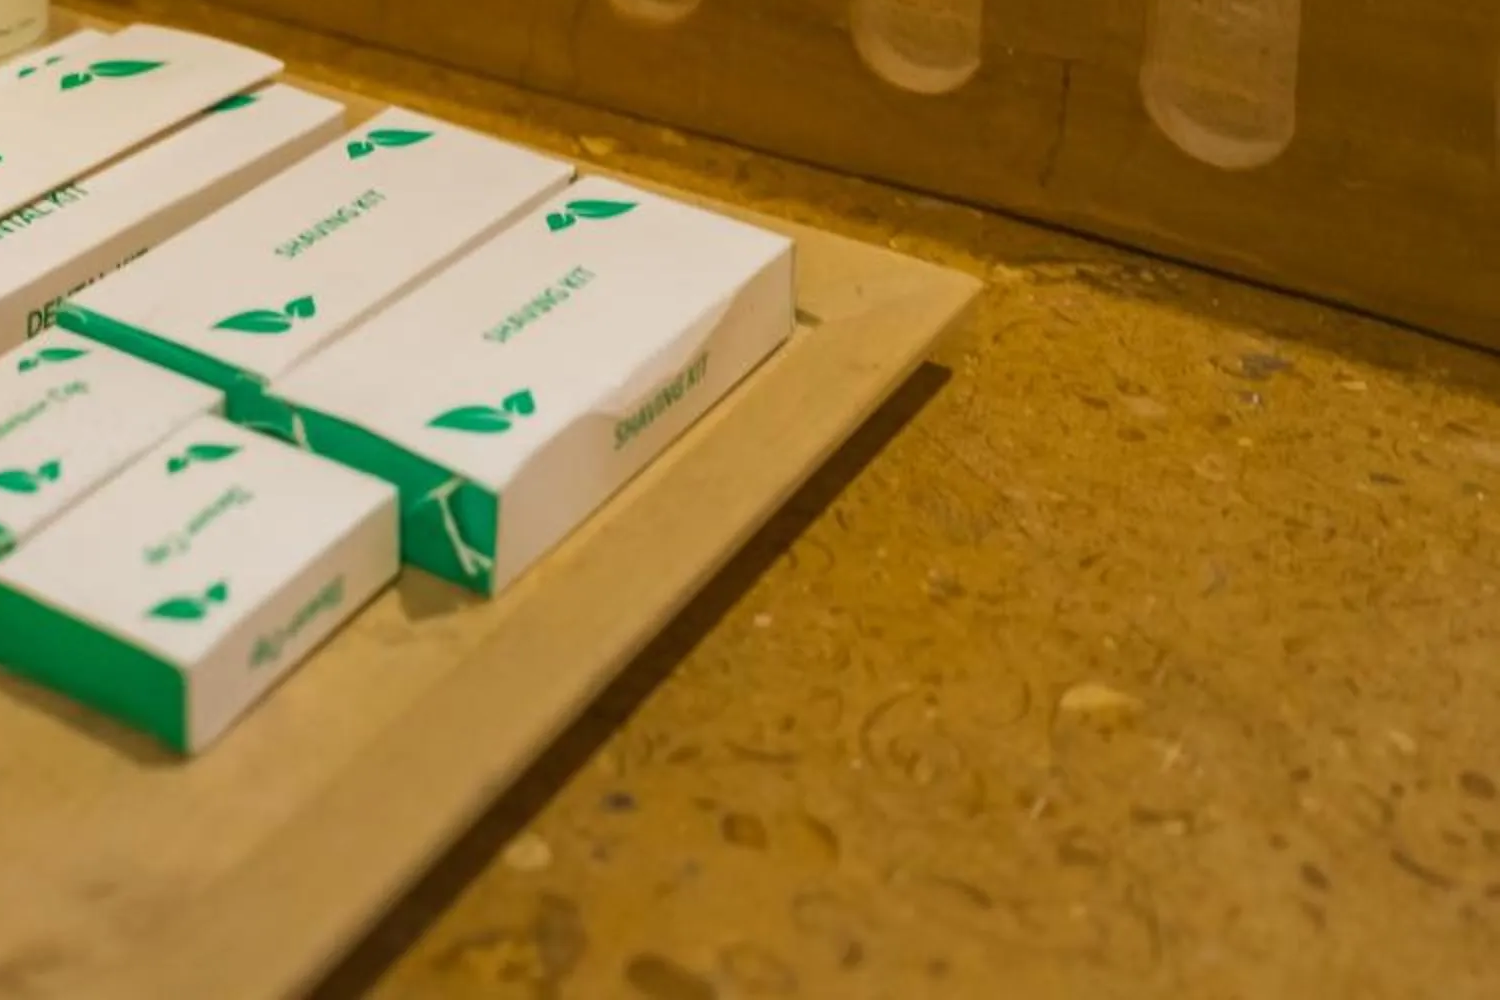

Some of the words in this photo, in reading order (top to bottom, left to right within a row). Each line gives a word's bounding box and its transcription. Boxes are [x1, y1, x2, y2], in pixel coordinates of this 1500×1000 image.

[274, 205, 361, 259] SHAVING
[352, 187, 387, 211] KIT
[482, 287, 570, 343] SHAVING
[557, 264, 597, 290] KIT
[612, 372, 686, 450] SHAVING
[685, 350, 709, 390] KIT
